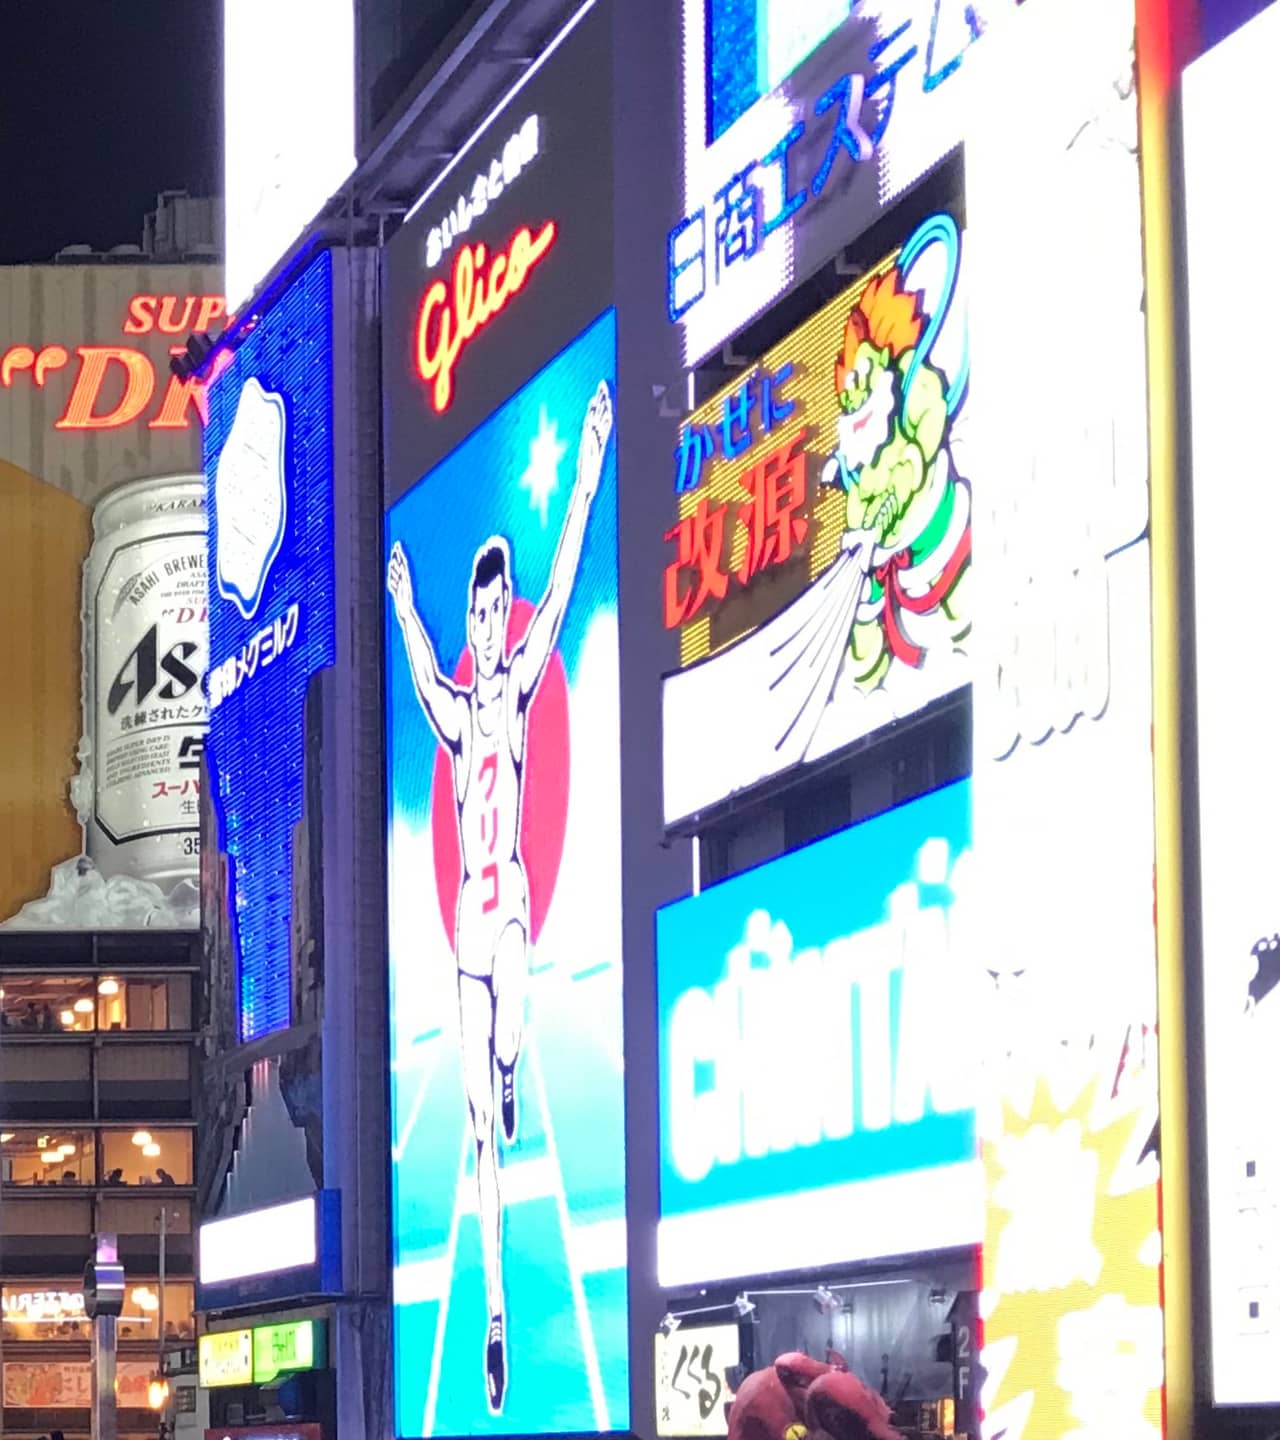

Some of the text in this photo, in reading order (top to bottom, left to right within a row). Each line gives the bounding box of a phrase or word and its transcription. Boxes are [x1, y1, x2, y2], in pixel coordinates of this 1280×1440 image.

[124, 297, 228, 334] SUP
[417, 218, 556, 412] Glico
[673, 362, 795, 493] かぜに
[663, 427, 808, 630] 改源
[128, 571, 160, 606] ASAHI
[672, 1343, 721, 1420] くくる
[958, 1325, 971, 1401] 2F
